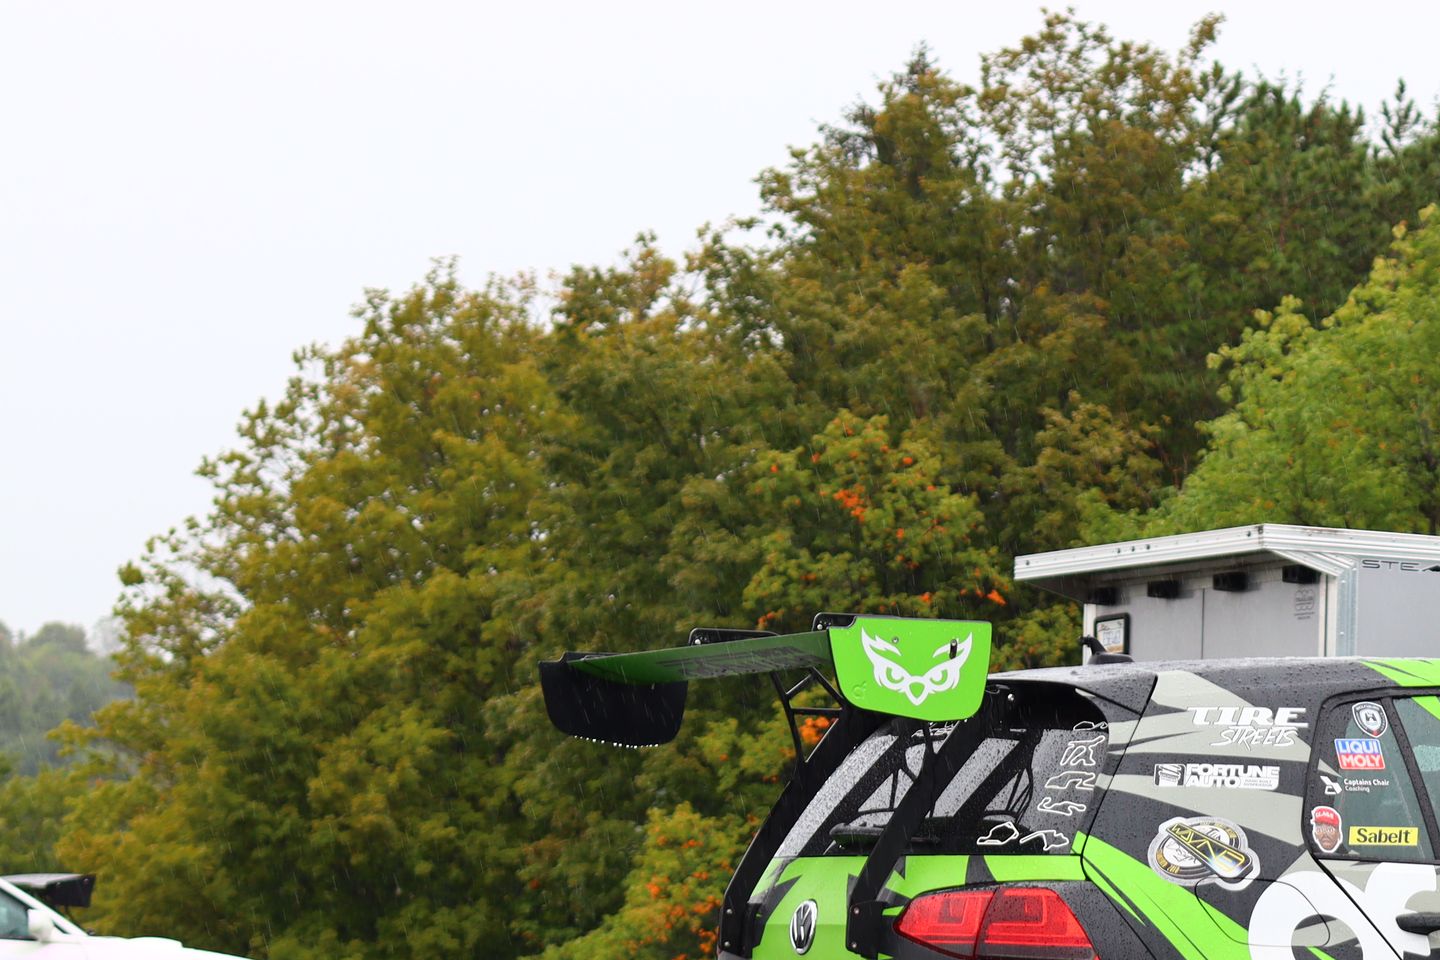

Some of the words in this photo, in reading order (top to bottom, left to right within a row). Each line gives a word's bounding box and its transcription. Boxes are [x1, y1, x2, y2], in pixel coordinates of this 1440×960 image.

[1187, 706, 1309, 728] TIRE
[1210, 726, 1298, 751] STREETS
[1337, 740, 1379, 754] LIQUI
[1341, 754, 1382, 767] MOLY
[1185, 763, 1281, 777] FORTUNE
[1185, 776, 1241, 788] AUTO
[1343, 778, 1372, 787] Captains
[1345, 785, 1370, 793] Coaching
[1356, 827, 1411, 844] Sabelt
